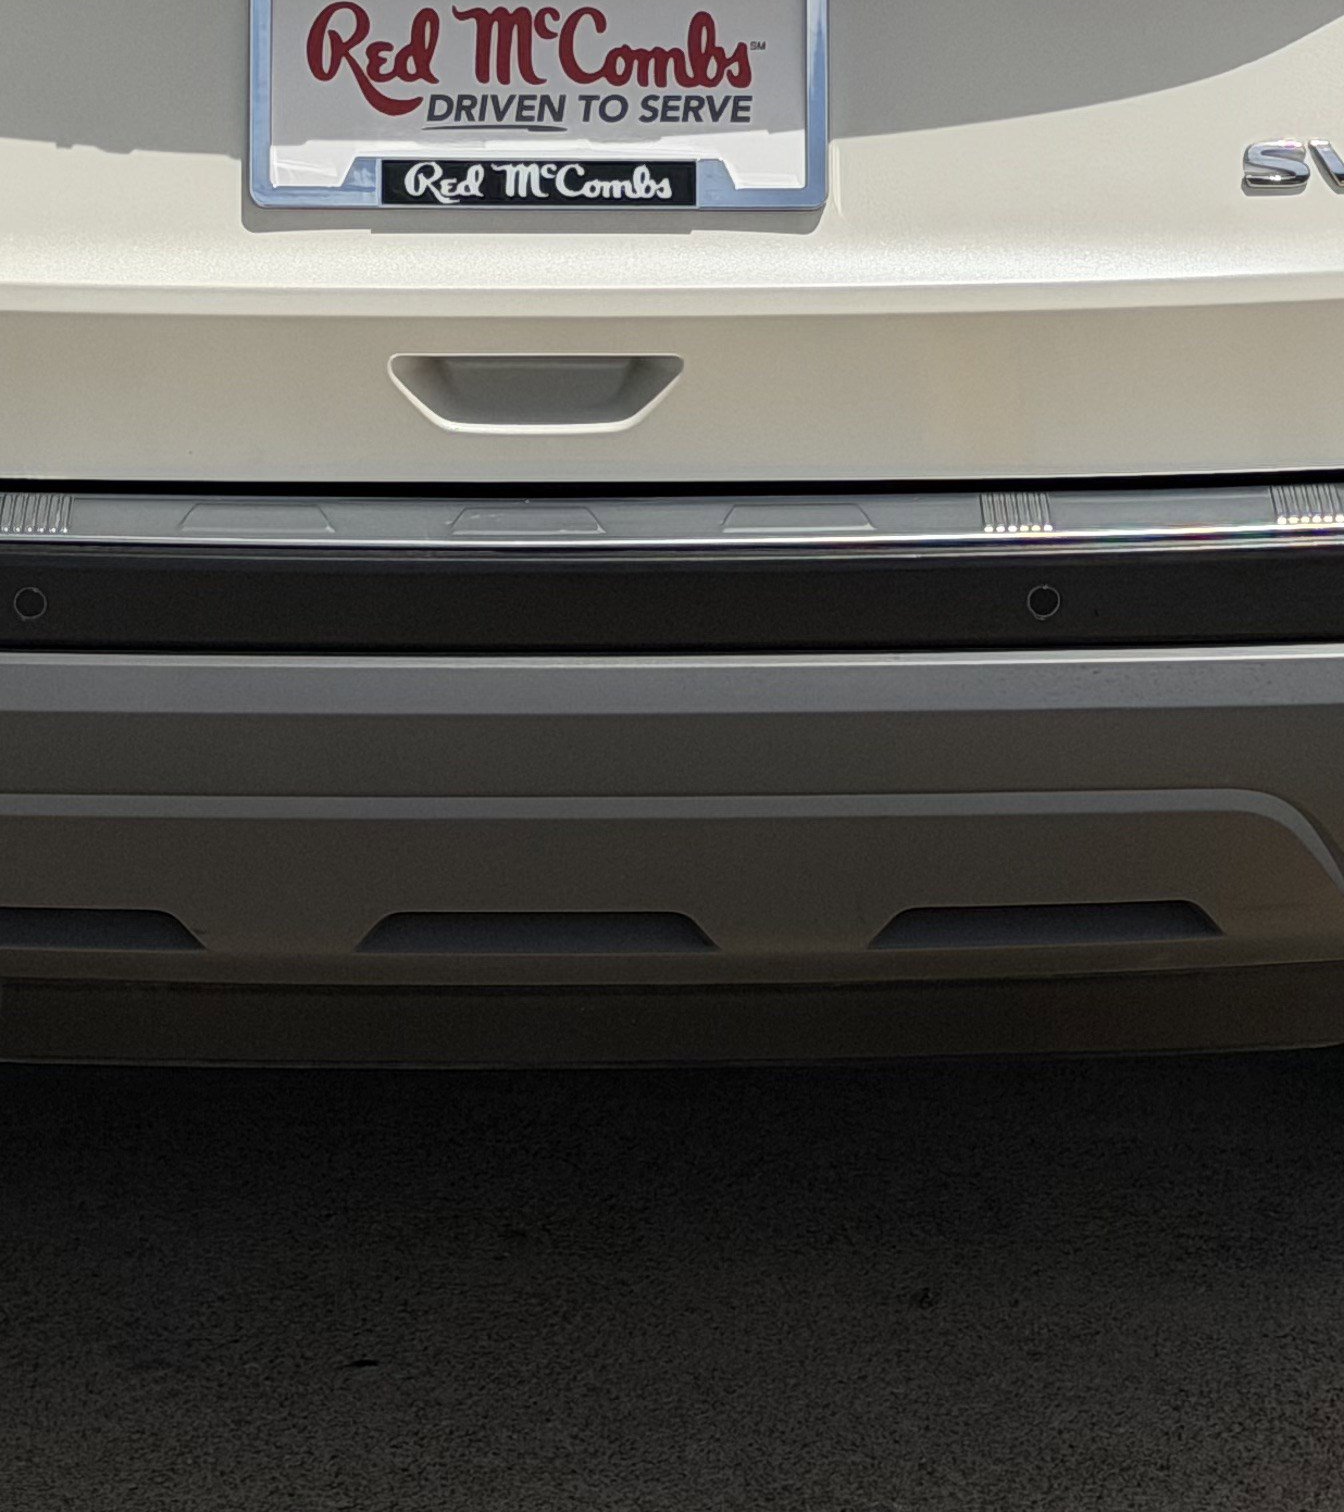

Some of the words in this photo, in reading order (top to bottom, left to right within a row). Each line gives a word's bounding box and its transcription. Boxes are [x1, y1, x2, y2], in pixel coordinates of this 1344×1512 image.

[307, 1, 439, 116] Red
[452, 5, 752, 89] McCombs
[426, 94, 565, 122] DRIVEN
[578, 95, 630, 122] TO
[638, 95, 752, 123] SERVE
[404, 161, 483, 203] Red
[491, 163, 673, 200] McCombs
